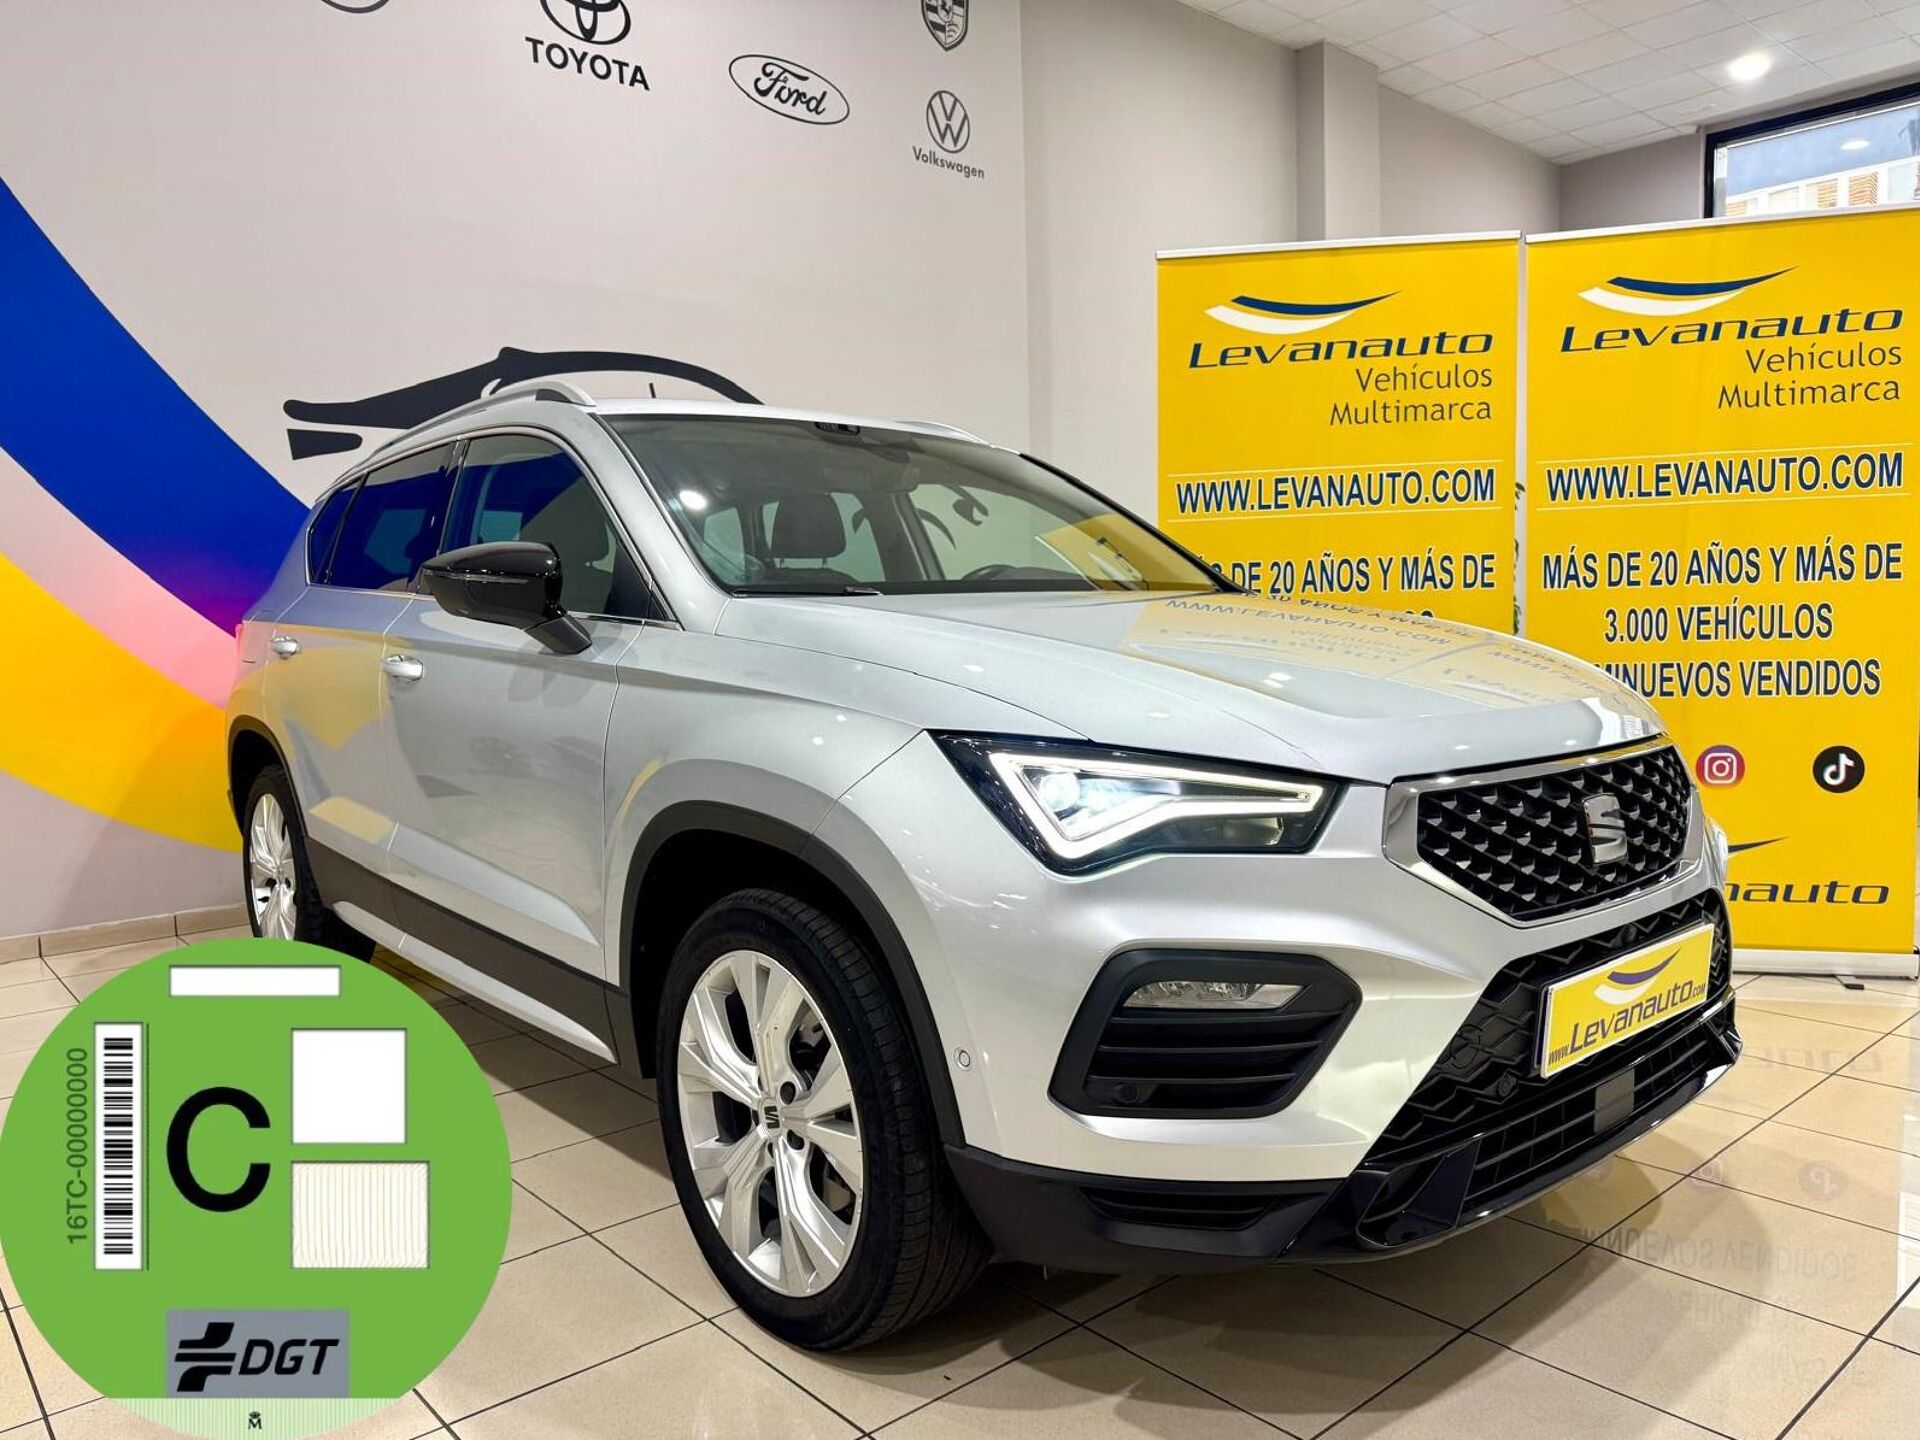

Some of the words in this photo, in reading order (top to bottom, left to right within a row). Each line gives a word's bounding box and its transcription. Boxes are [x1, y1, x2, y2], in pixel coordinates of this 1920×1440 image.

[525, 37, 650, 91] TOYOTA
[753, 61, 828, 116] Ford
[912, 146, 985, 179] Volkswagen
[1189, 331, 1494, 369] Levanauto
[1560, 308, 1903, 353] Levanauto
[1355, 362, 1493, 393] Vehículos
[1745, 341, 1902, 374] Vehículos
[1329, 399, 1492, 426] Multimarca
[1717, 379, 1900, 410] Multimarca
[1176, 468, 1494, 514] WWW.LEVANAUTO.COM
[1546, 452, 1903, 502] WWW.LEVANAUTO.COM
[1231, 561, 1262, 594] DE
[1269, 560, 1295, 595] 20
[1301, 552, 1370, 593] AÑOS
[1378, 557, 1393, 591] Y
[1401, 547, 1454, 590] MÁS
[1463, 554, 1495, 589] DE
[1543, 545, 1598, 589] MÁS
[1607, 551, 1641, 588] DE
[1649, 550, 1678, 586] 20
[1685, 541, 1761, 585] AÑOS
[1769, 546, 1787, 583] Y
[1795, 536, 1855, 582] MÁS
[1865, 543, 1902, 580] DE
[1605, 607, 1668, 643] 3.000
[1677, 597, 1833, 641] VEHÍCULOS
[1739, 658, 1881, 696] VENDIDOS
